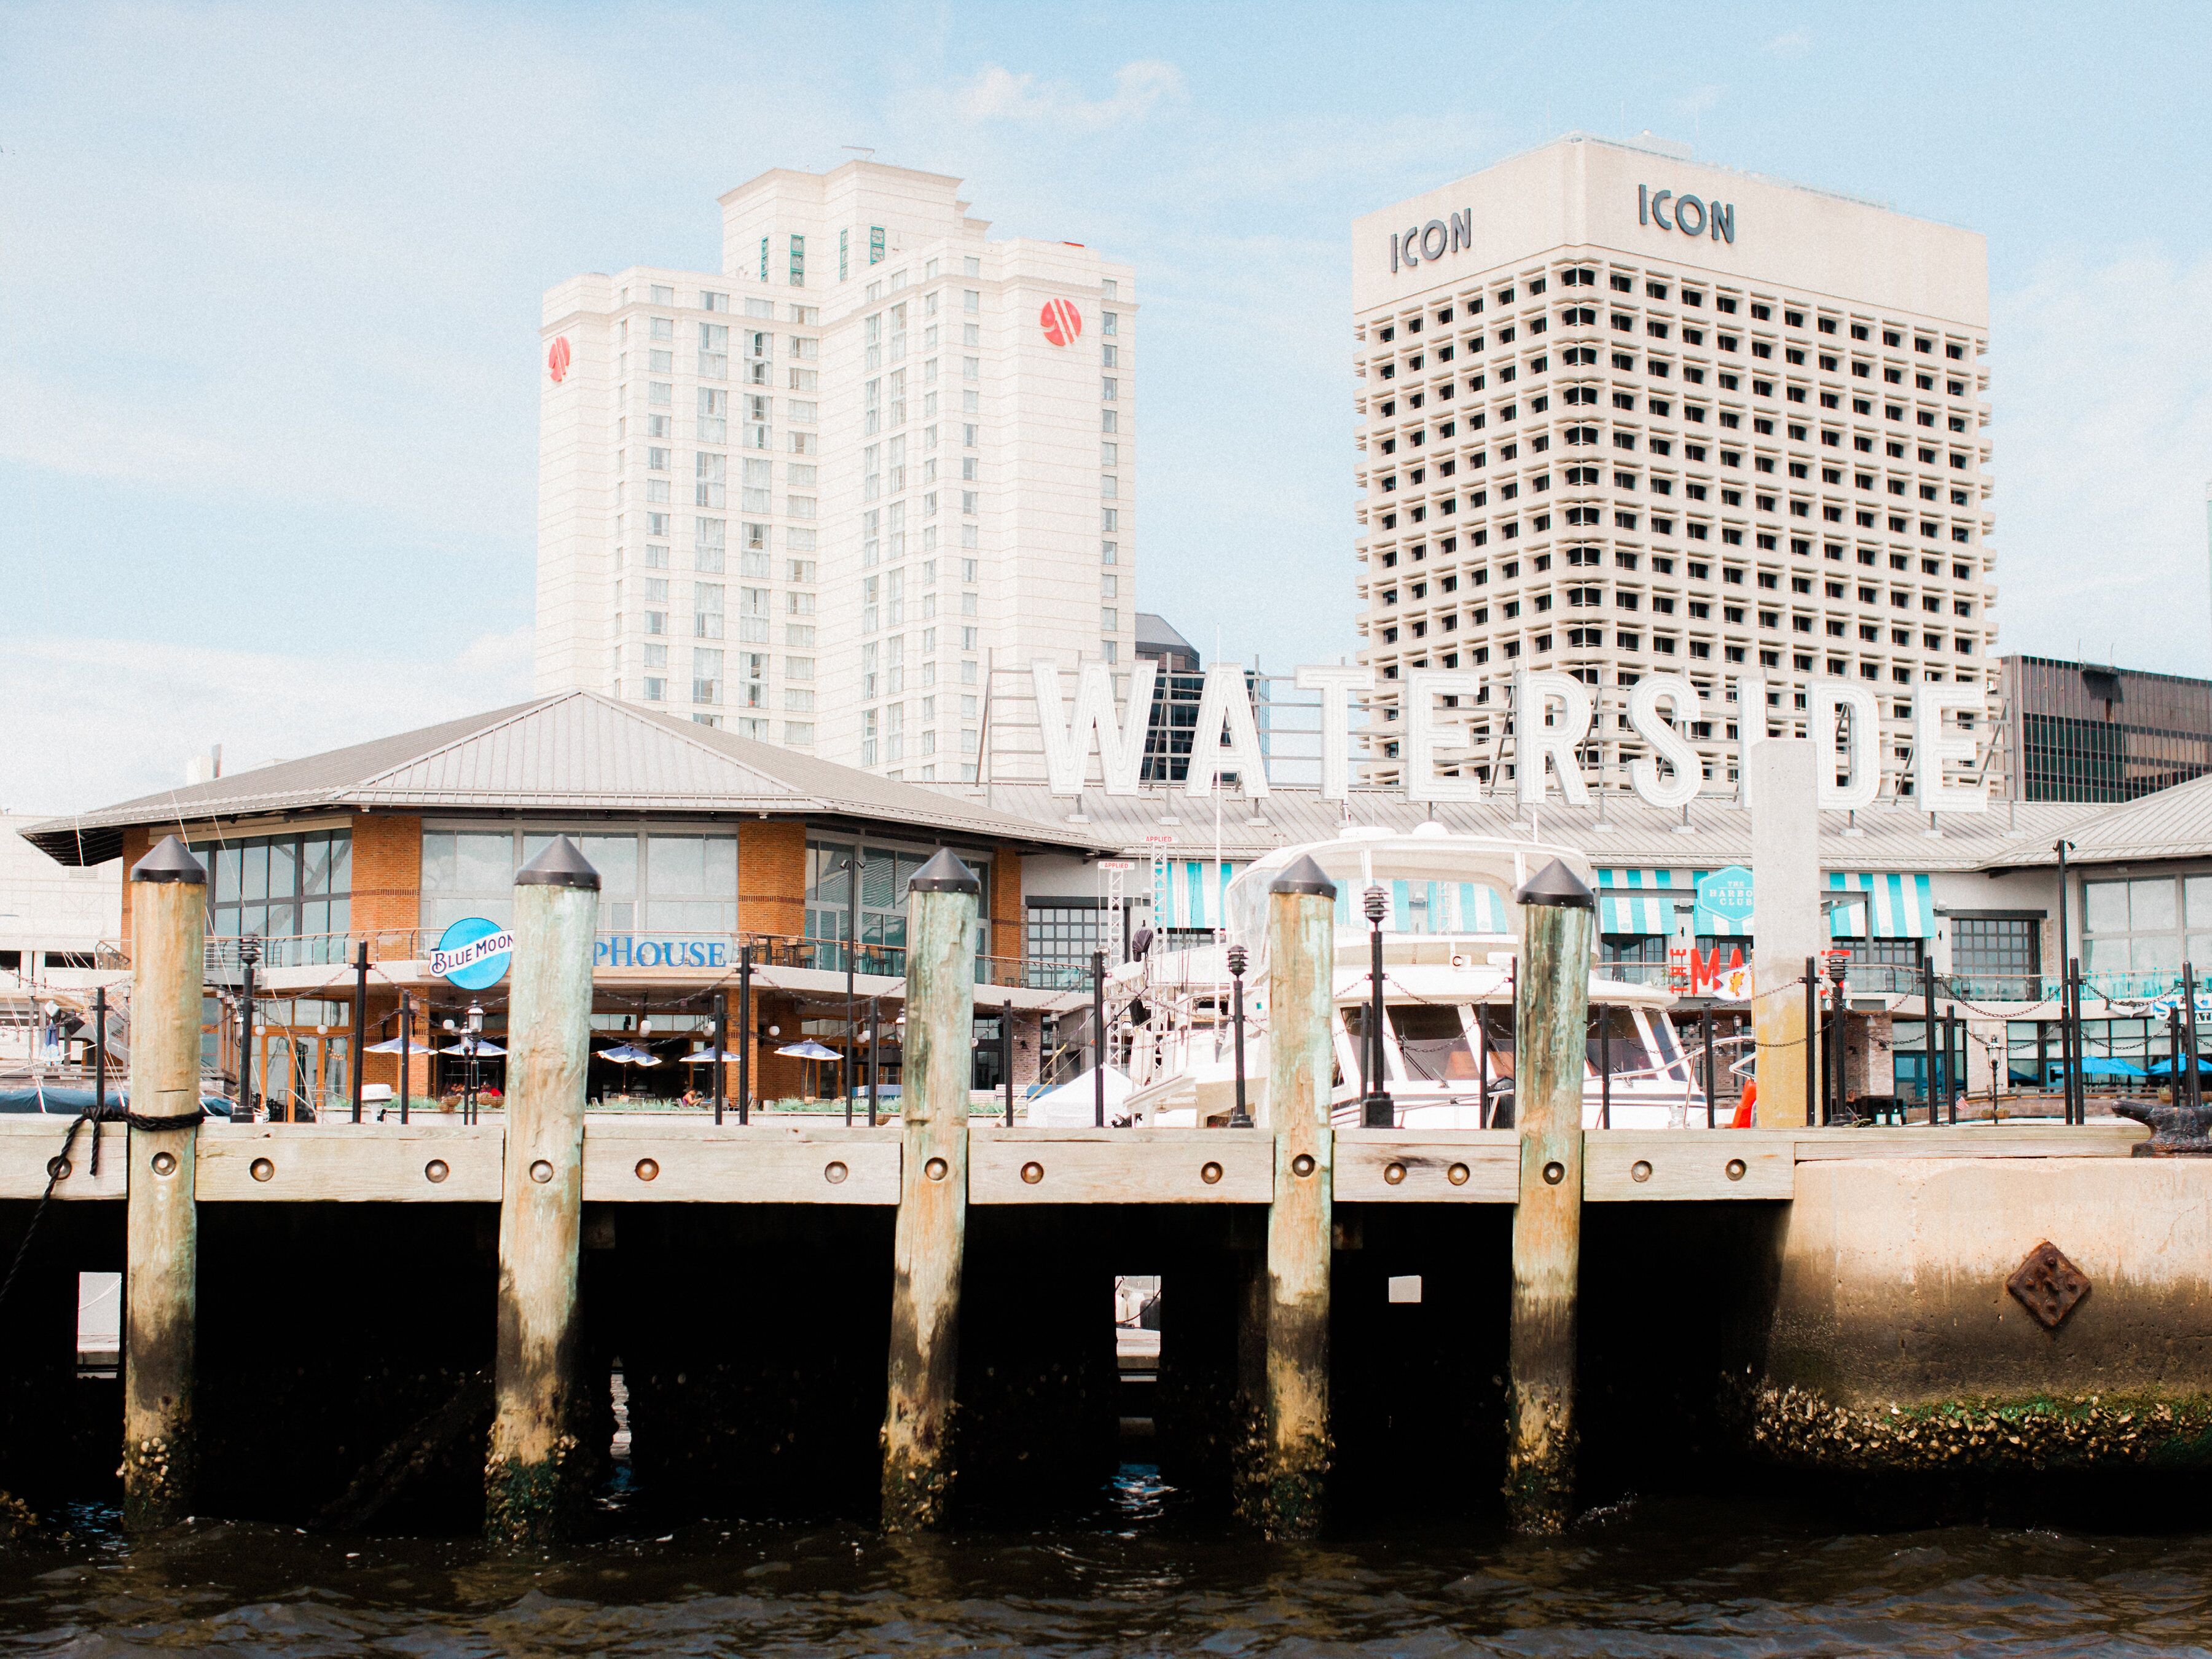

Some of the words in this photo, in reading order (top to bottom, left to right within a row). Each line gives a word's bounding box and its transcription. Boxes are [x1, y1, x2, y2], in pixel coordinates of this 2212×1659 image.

[1390, 208, 1471, 273] ICON
[1639, 184, 1735, 244] ICON
[1030, 658, 1988, 813] WATERSIDE
[432, 948, 472, 974] BLUE
